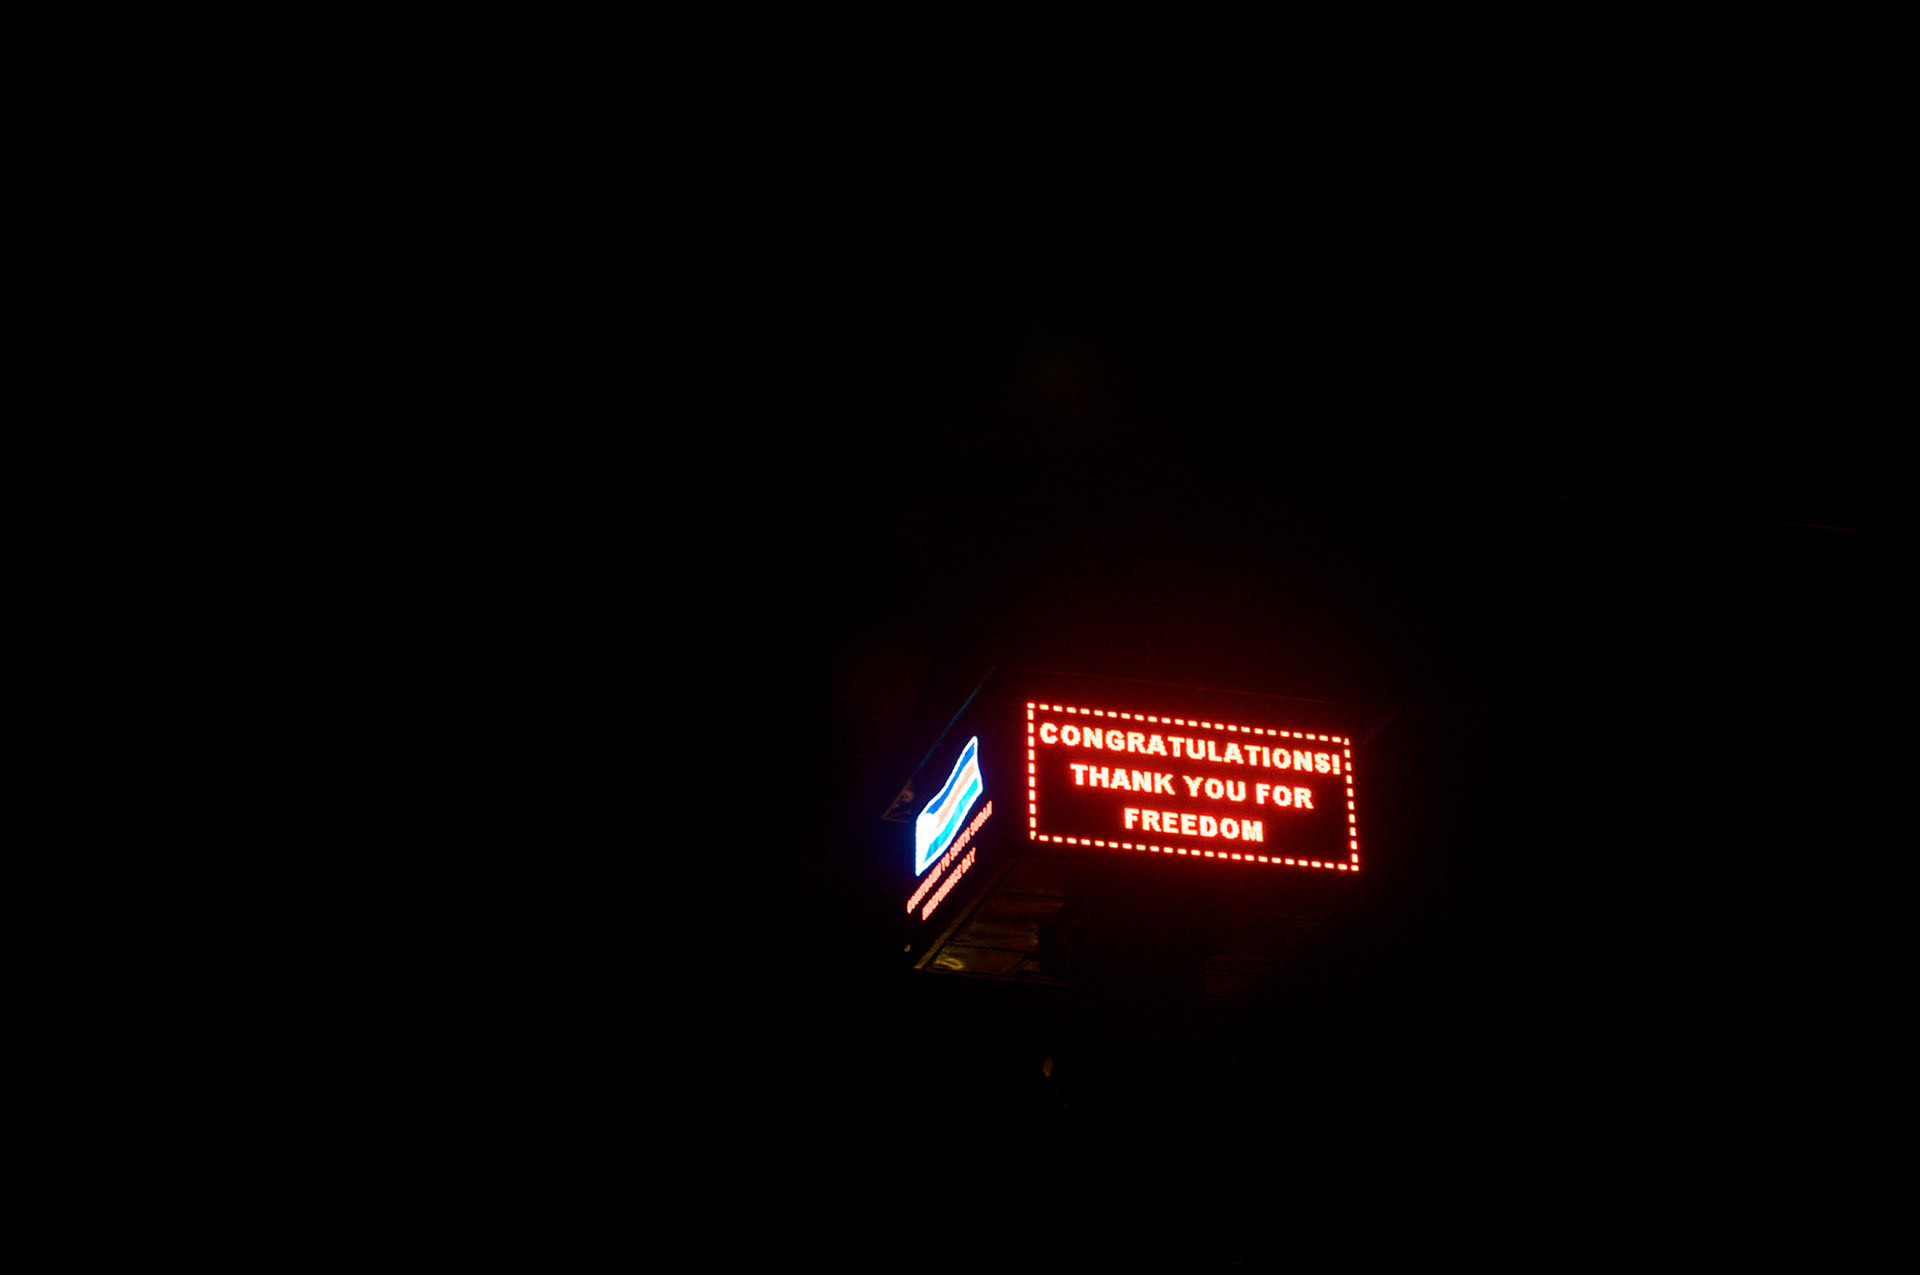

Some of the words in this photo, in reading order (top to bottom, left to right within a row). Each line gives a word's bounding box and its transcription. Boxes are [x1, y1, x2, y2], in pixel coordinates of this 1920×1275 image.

[1039, 722, 1341, 775] CONGRATULATIONS!
[1070, 763, 1176, 795] THANK
[1182, 775, 1247, 802] YOU
[1255, 783, 1314, 809] FOR
[1124, 807, 1264, 842] FREEDOM
